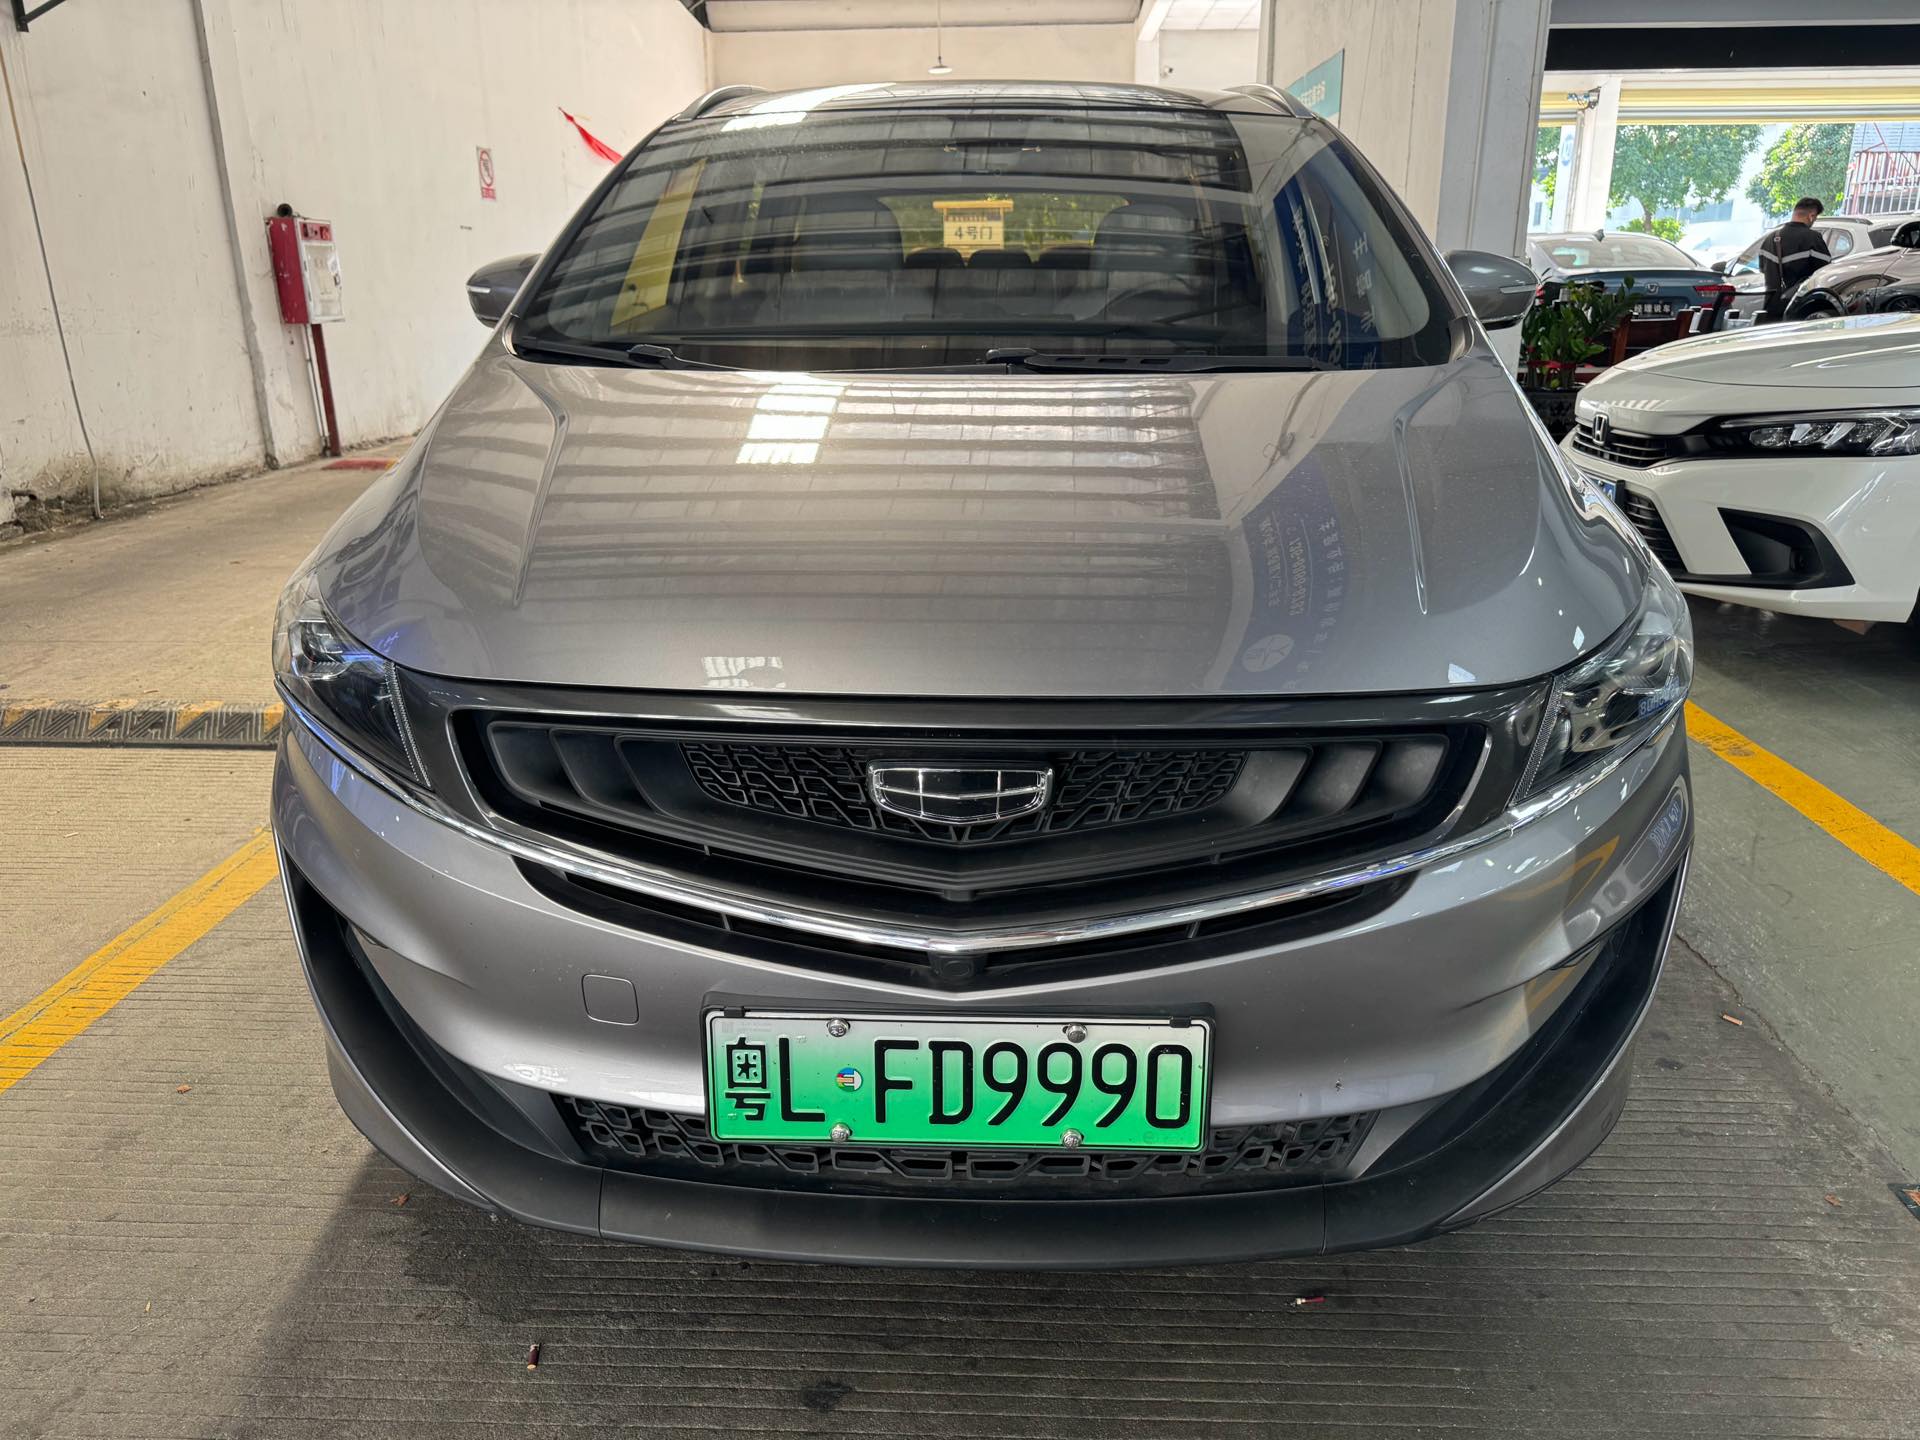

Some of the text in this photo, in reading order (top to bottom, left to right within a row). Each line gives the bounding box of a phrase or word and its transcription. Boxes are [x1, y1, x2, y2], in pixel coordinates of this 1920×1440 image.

[1634, 304, 1671, 313] 经理说车
[874, 1039, 1193, 1129] FD9990
